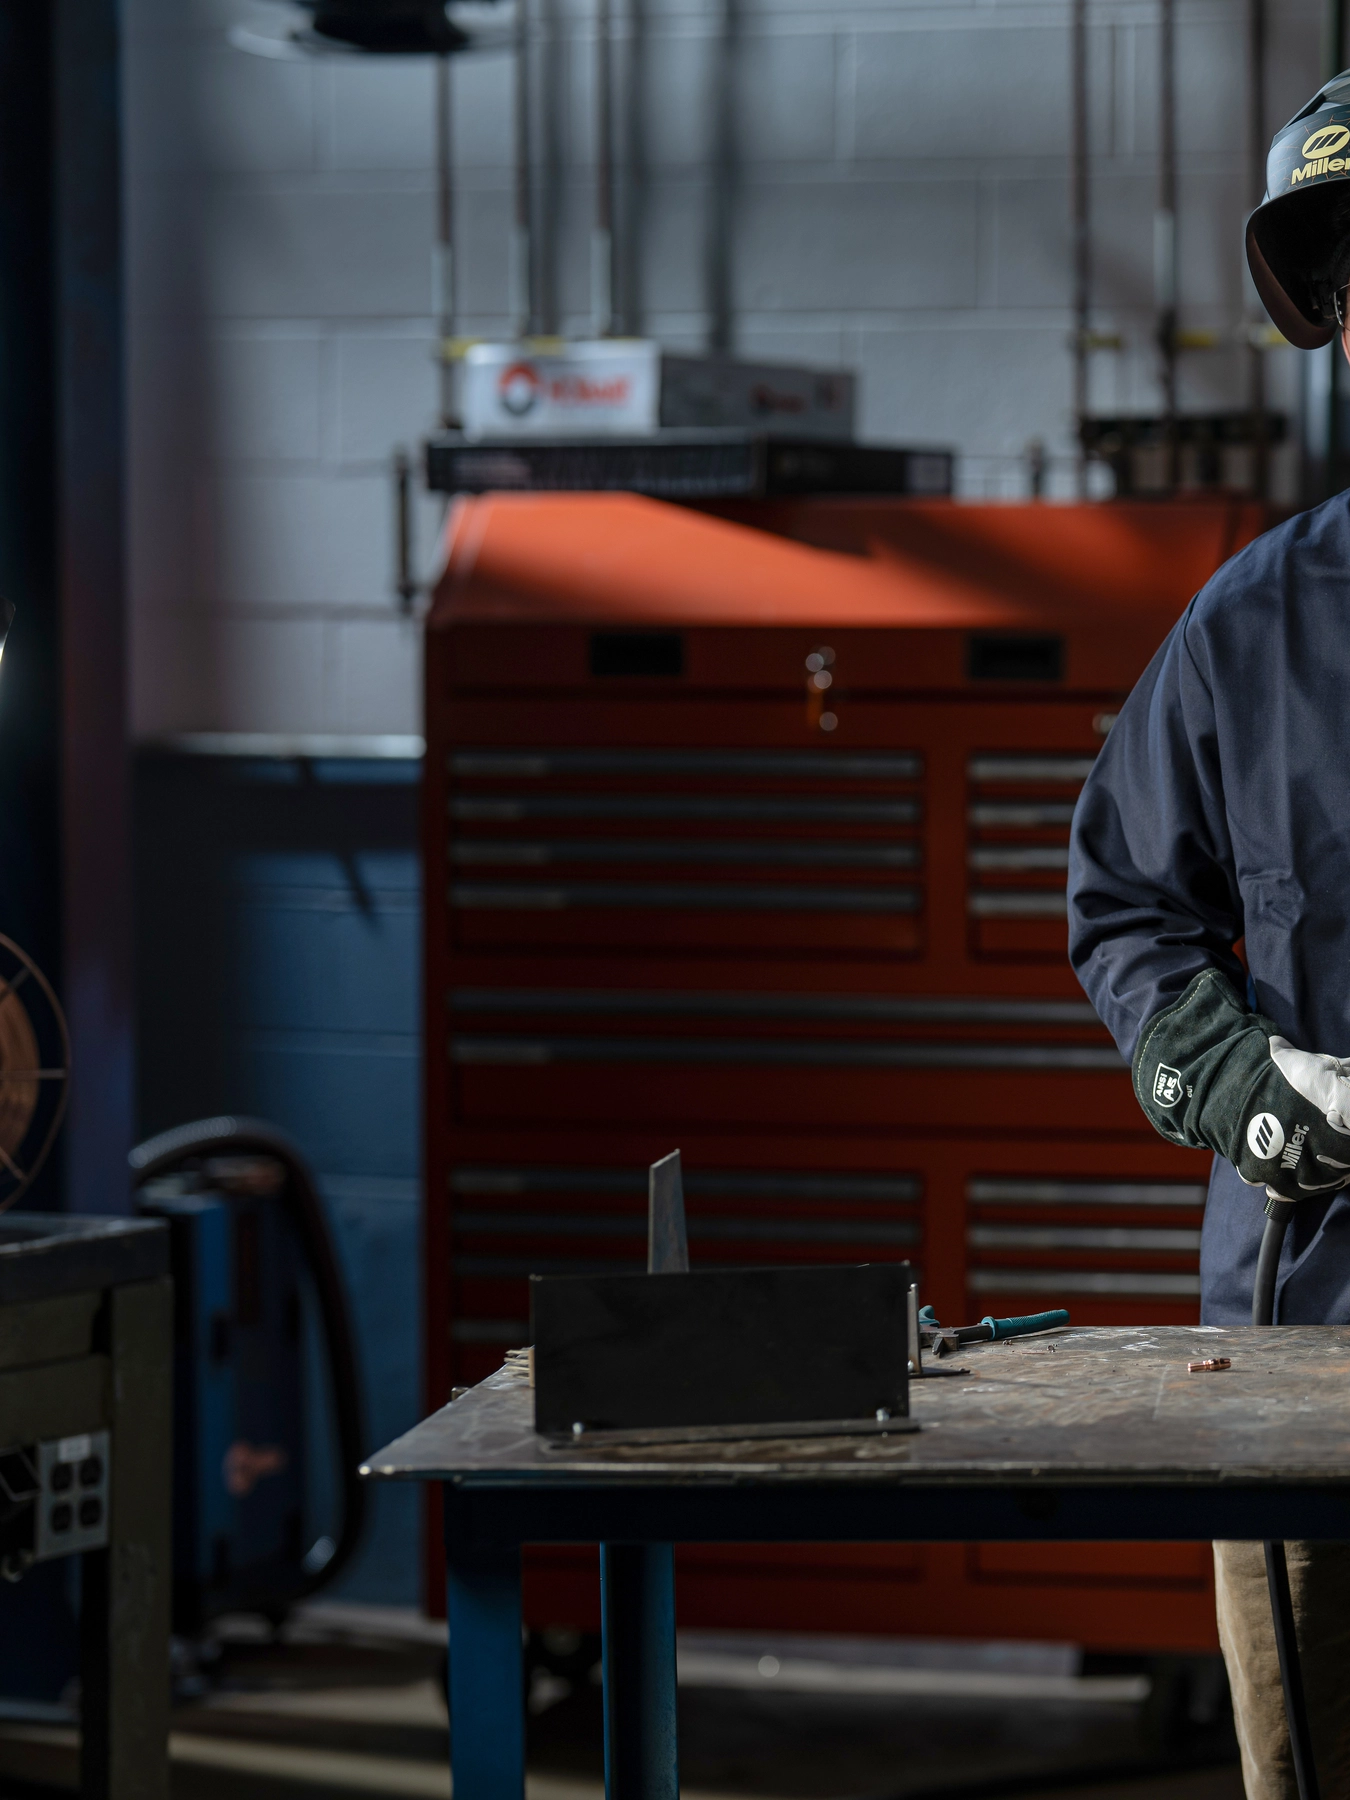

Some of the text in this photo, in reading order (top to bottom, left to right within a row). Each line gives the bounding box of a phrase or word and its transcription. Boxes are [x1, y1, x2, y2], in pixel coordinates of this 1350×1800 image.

[1156, 1073, 1168, 1097] ANSI
[1163, 1076, 1178, 1102] A5
[1185, 1084, 1193, 1098] CUT
